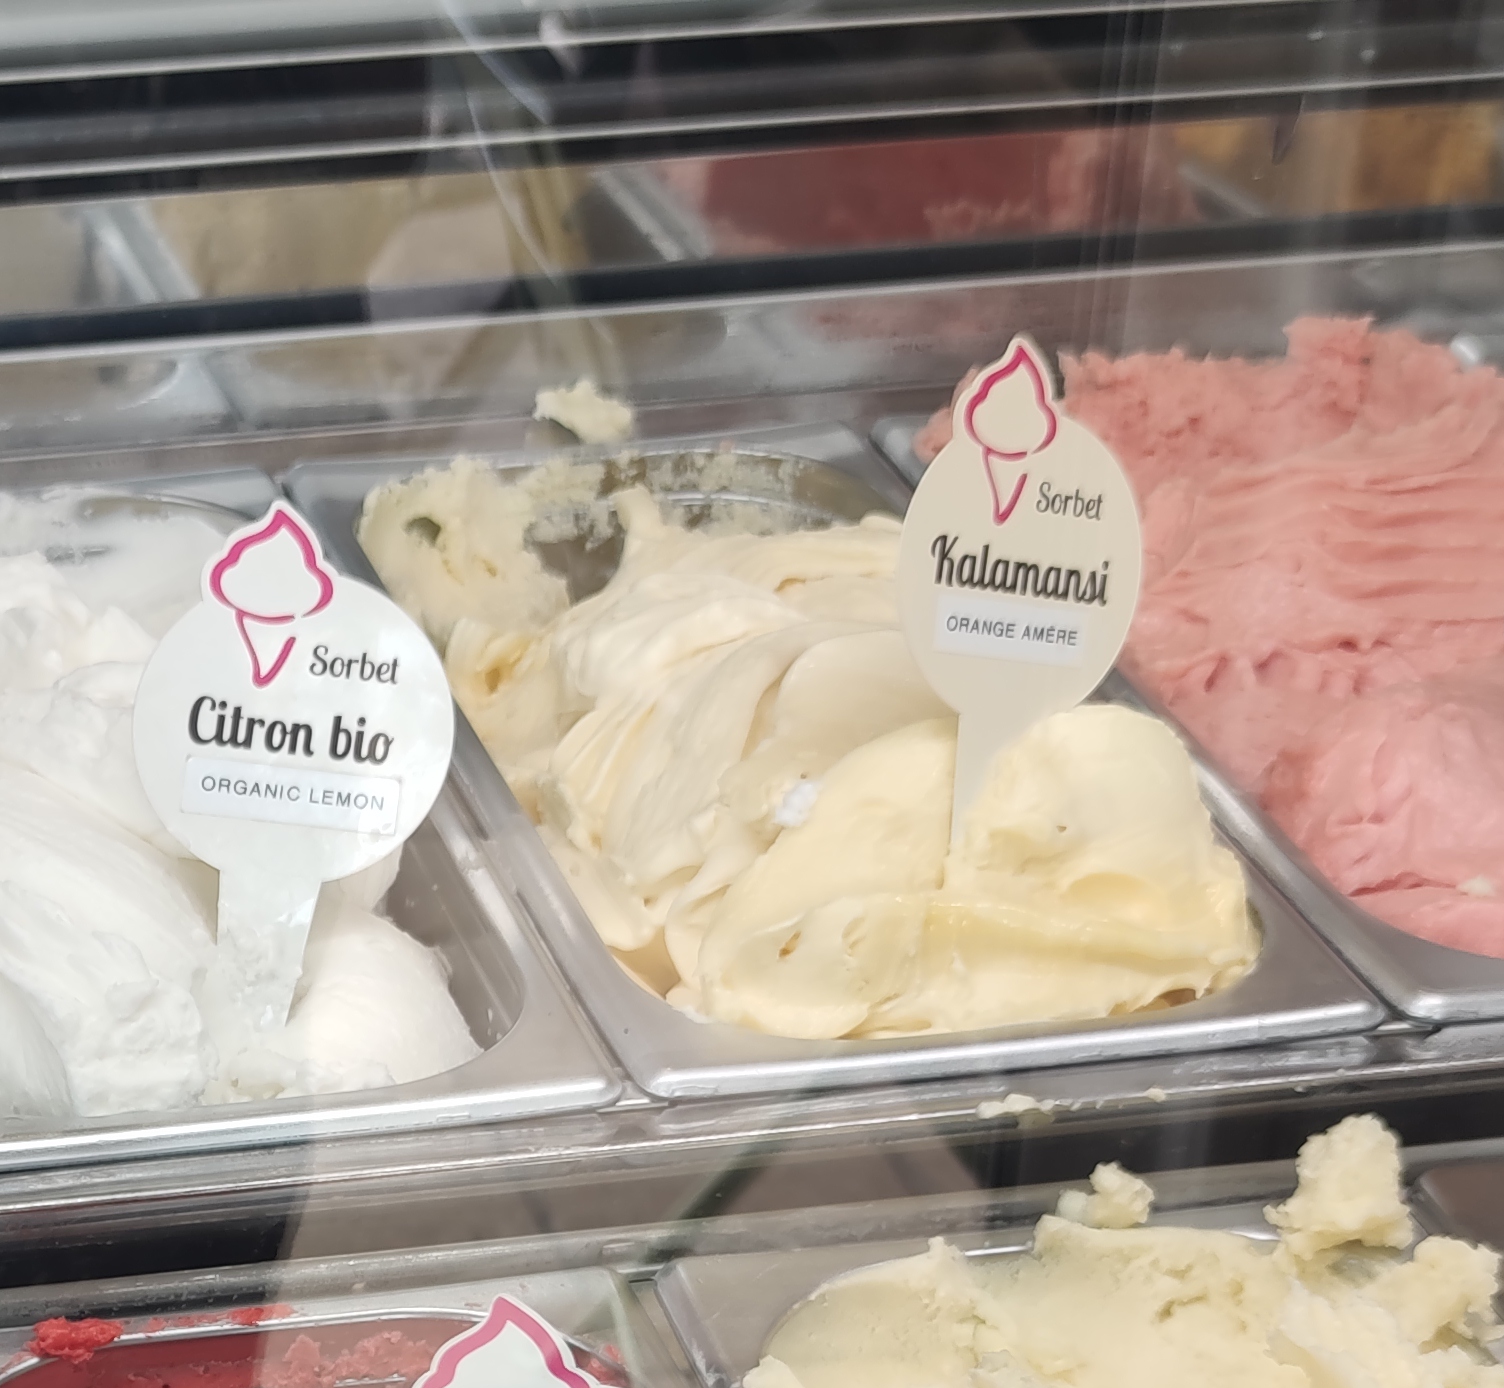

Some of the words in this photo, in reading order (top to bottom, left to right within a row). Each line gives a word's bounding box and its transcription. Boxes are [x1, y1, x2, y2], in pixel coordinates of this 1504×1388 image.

[1036, 481, 1103, 520] Sorbet
[931, 534, 1109, 607] Kalamansi
[946, 615, 1016, 639] ORANGE
[309, 645, 398, 685] Sorbet
[188, 695, 314, 758] Citron
[328, 715, 394, 765] bio
[201, 776, 301, 802] ORGANIC
[309, 788, 384, 811] LEMON
